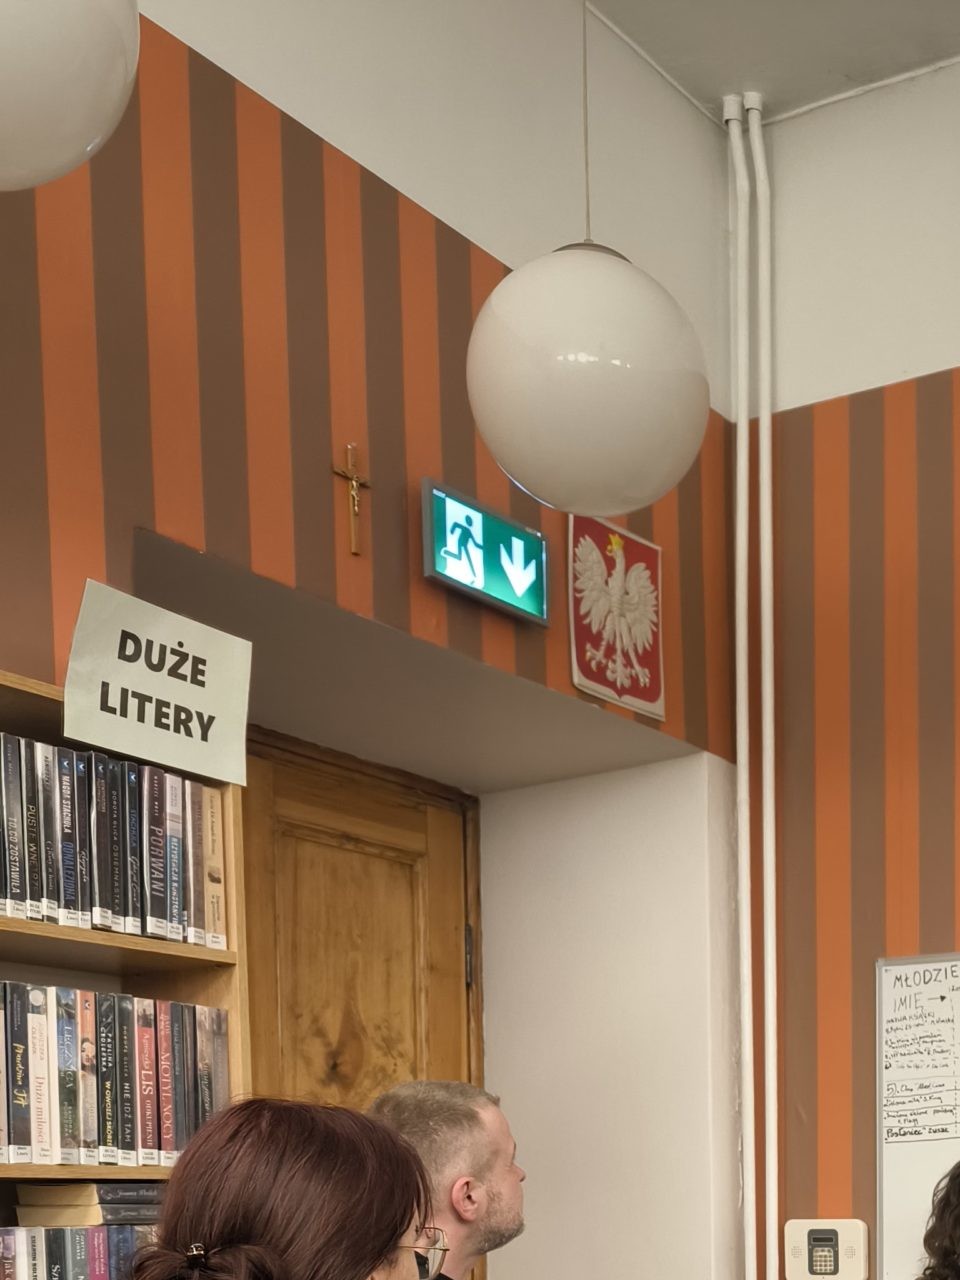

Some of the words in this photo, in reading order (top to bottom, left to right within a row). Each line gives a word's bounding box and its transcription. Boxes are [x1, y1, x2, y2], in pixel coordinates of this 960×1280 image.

[117, 629, 207, 688] DUŻE
[99, 680, 216, 743] LITERY
[150, 825, 165, 898] PORWANI
[123, 1082, 131, 1099] NIE
[141, 1069, 154, 1095] LIS
[124, 1122, 132, 1143] TAM
[3, 1259, 14, 1275] Jak
